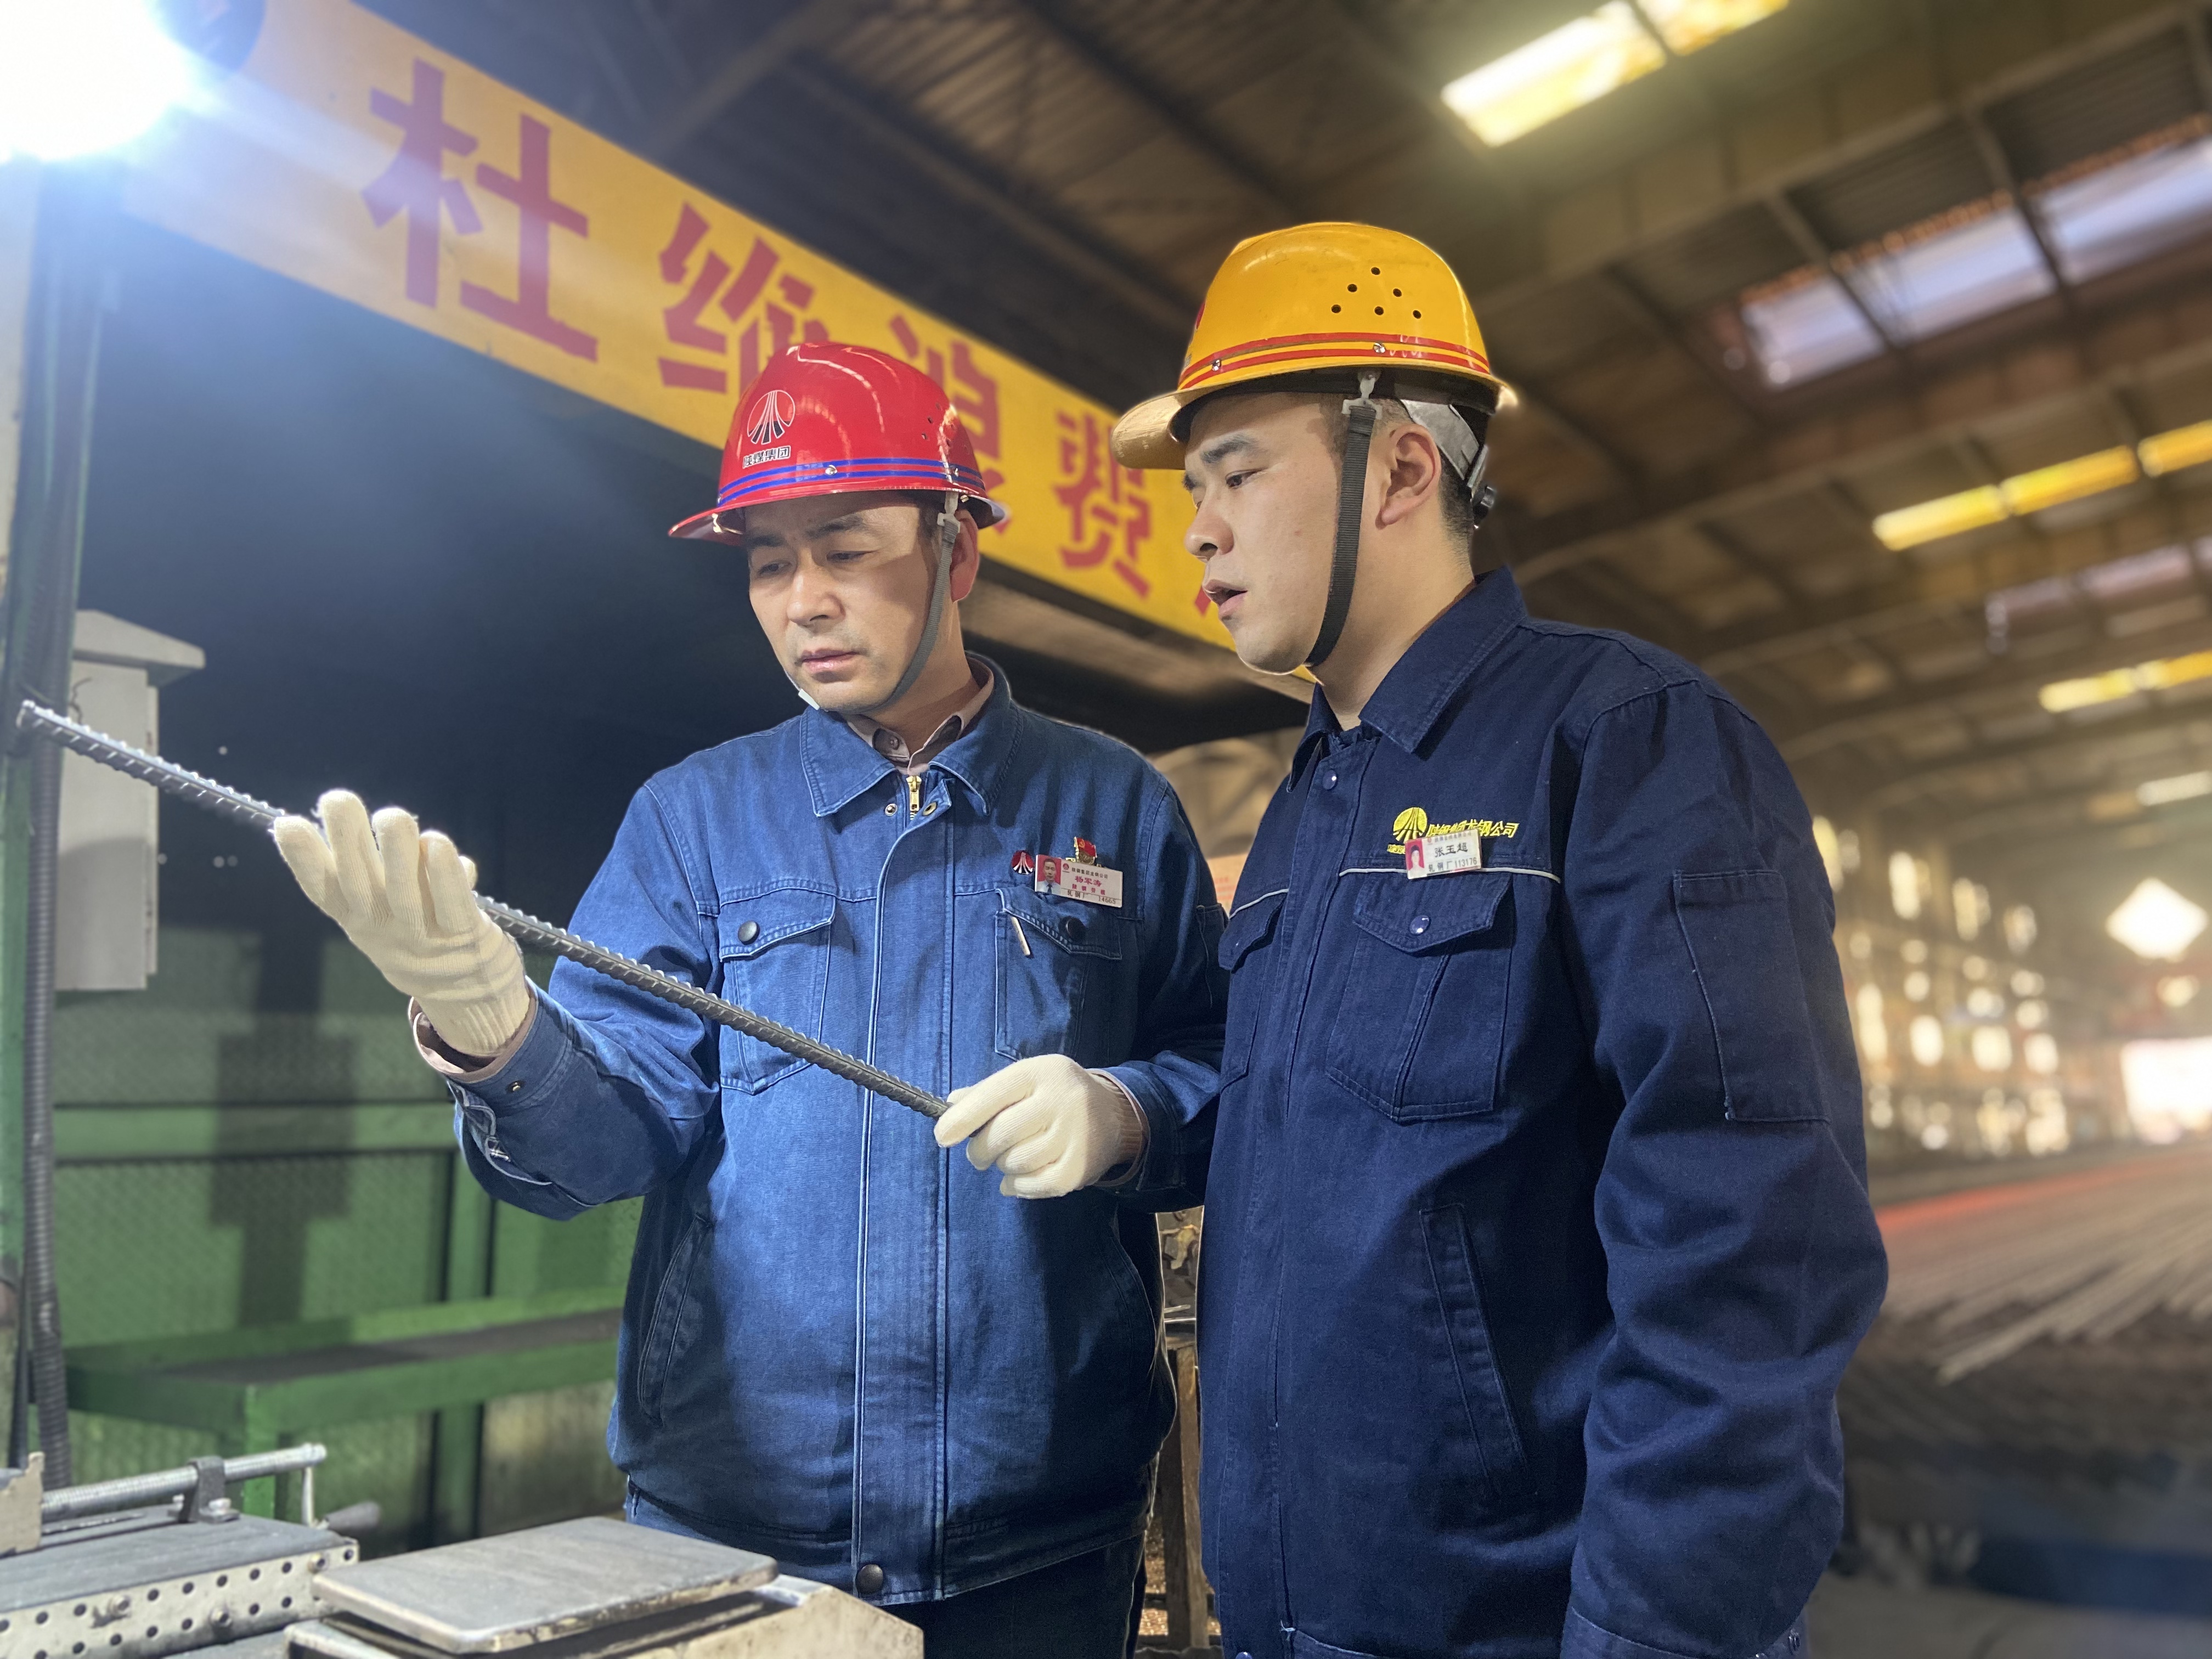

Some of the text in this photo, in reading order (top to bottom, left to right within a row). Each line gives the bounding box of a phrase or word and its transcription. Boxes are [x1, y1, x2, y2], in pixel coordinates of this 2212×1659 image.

[360, 58, 1211, 616] 杜绝浪费
[743, 446, 791, 467] 陕煤集团
[1434, 842, 1468, 857] 张玉超
[1454, 857, 1477, 868] 113176
